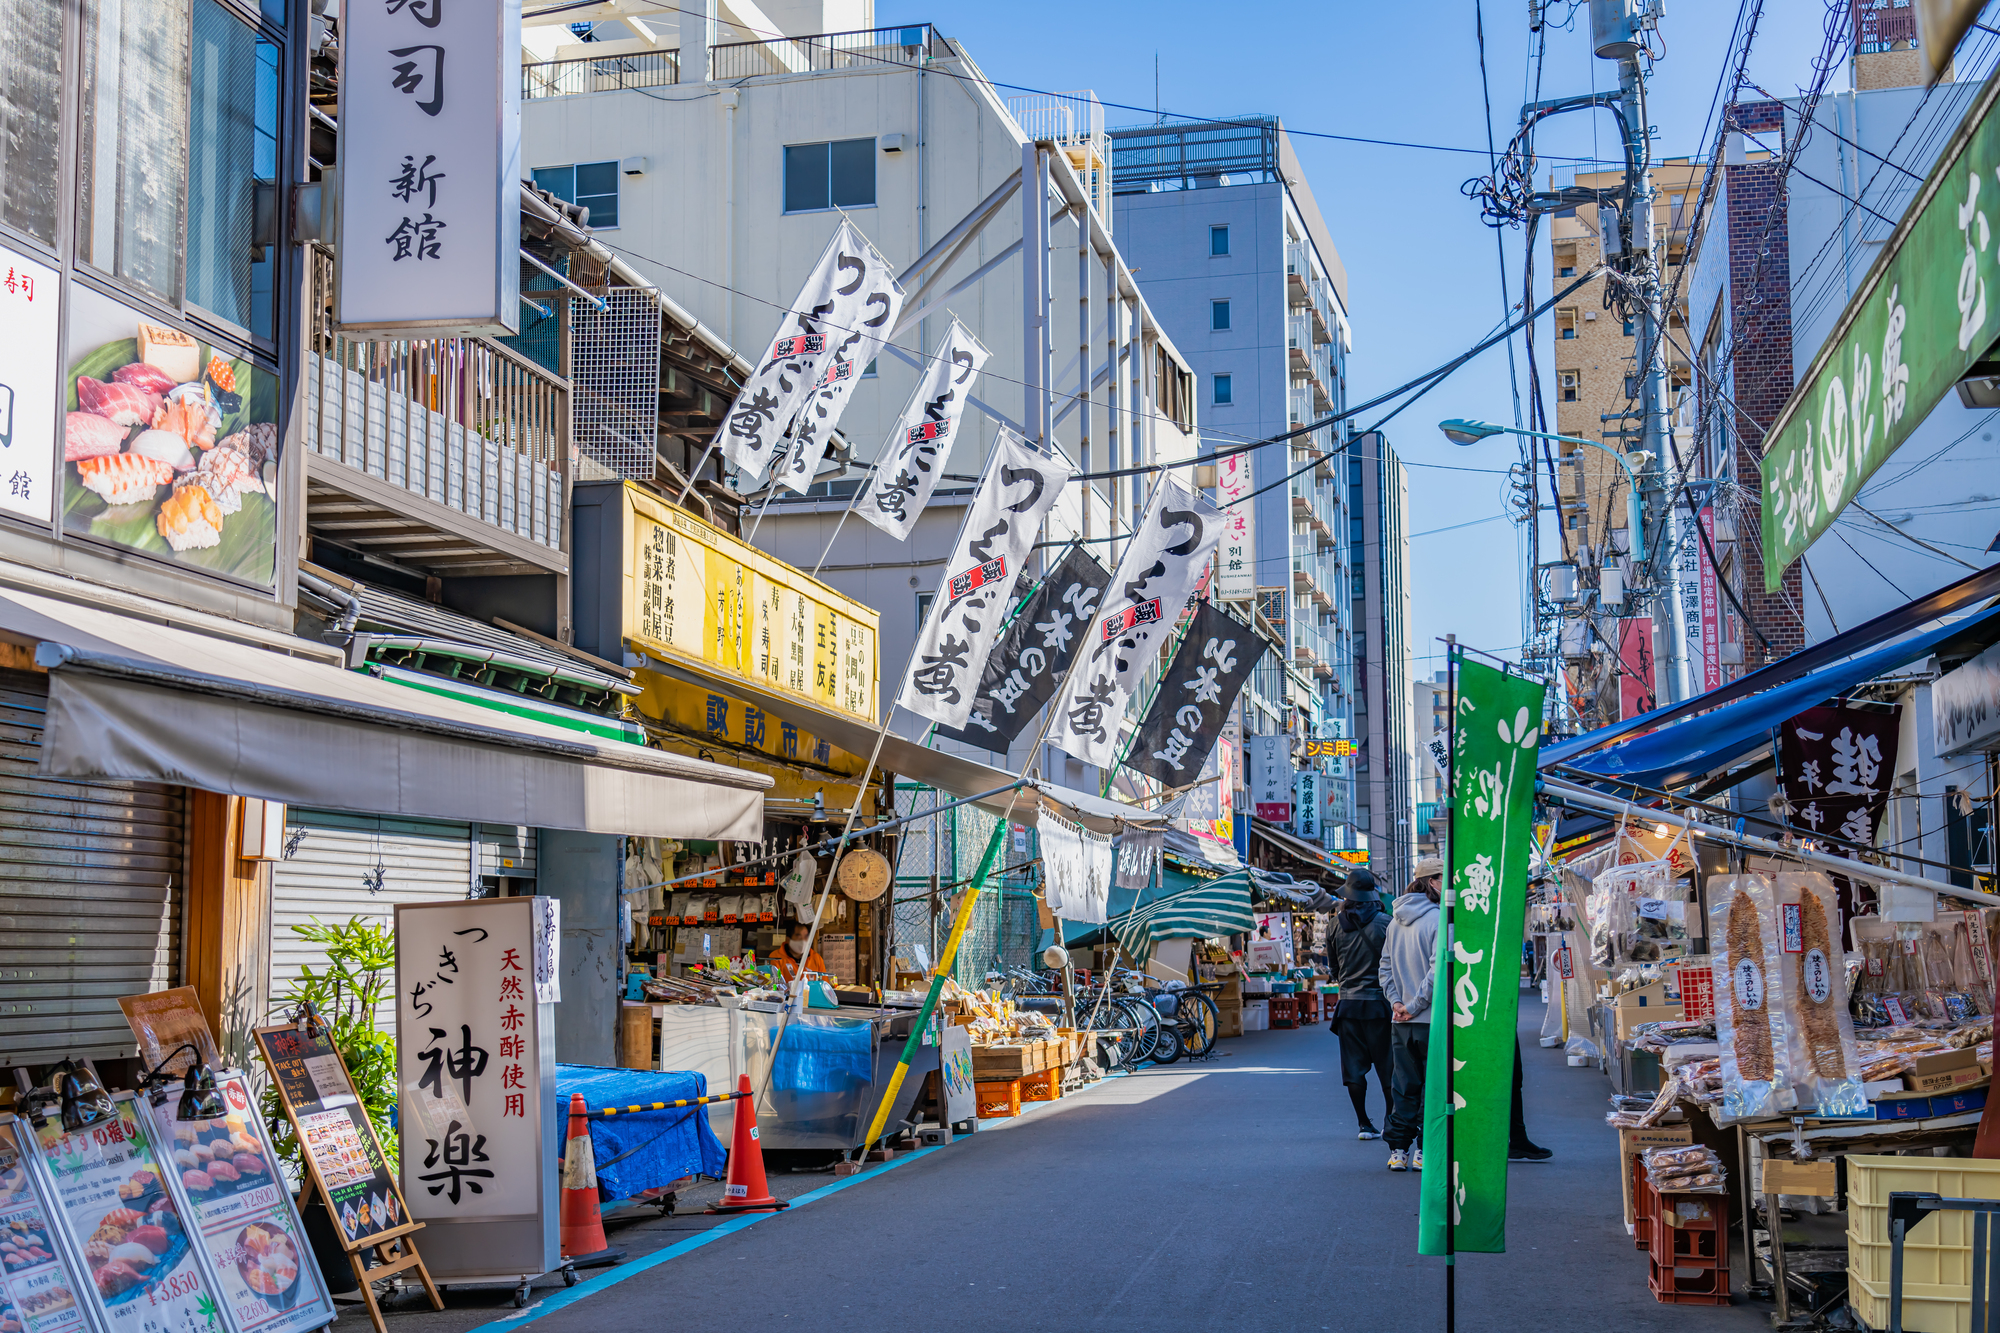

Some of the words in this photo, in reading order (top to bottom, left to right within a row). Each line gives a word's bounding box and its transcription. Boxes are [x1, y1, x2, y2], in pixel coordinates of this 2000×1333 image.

[385, 155, 446, 262] 新館
[4, 266, 34, 302] 寿司
[1228, 546, 1243, 571] 別館
[652, 525, 664, 641] 惣菜問屋
[1685, 581, 1700, 638] 吉澤商店
[706, 693, 831, 766] 諏訪市場
[1306, 740, 1350, 757] シミ用
[409, 926, 489, 1020] つきぢ
[1742, 964, 1758, 1006] 焼きのしいか
[1811, 954, 1826, 997] 焼きのしいか
[498, 947, 527, 1119] 天然赤酢使用
[275, 1060, 290, 1073] TAKE
[416, 1023, 495, 1206] 神楽
[56, 1158, 106, 1178] Recommended
[241, 1187, 275, 1210] ¥2,600
[143, 1270, 199, 1307] ¥3,850
[236, 1298, 270, 1324] ¥2,600
